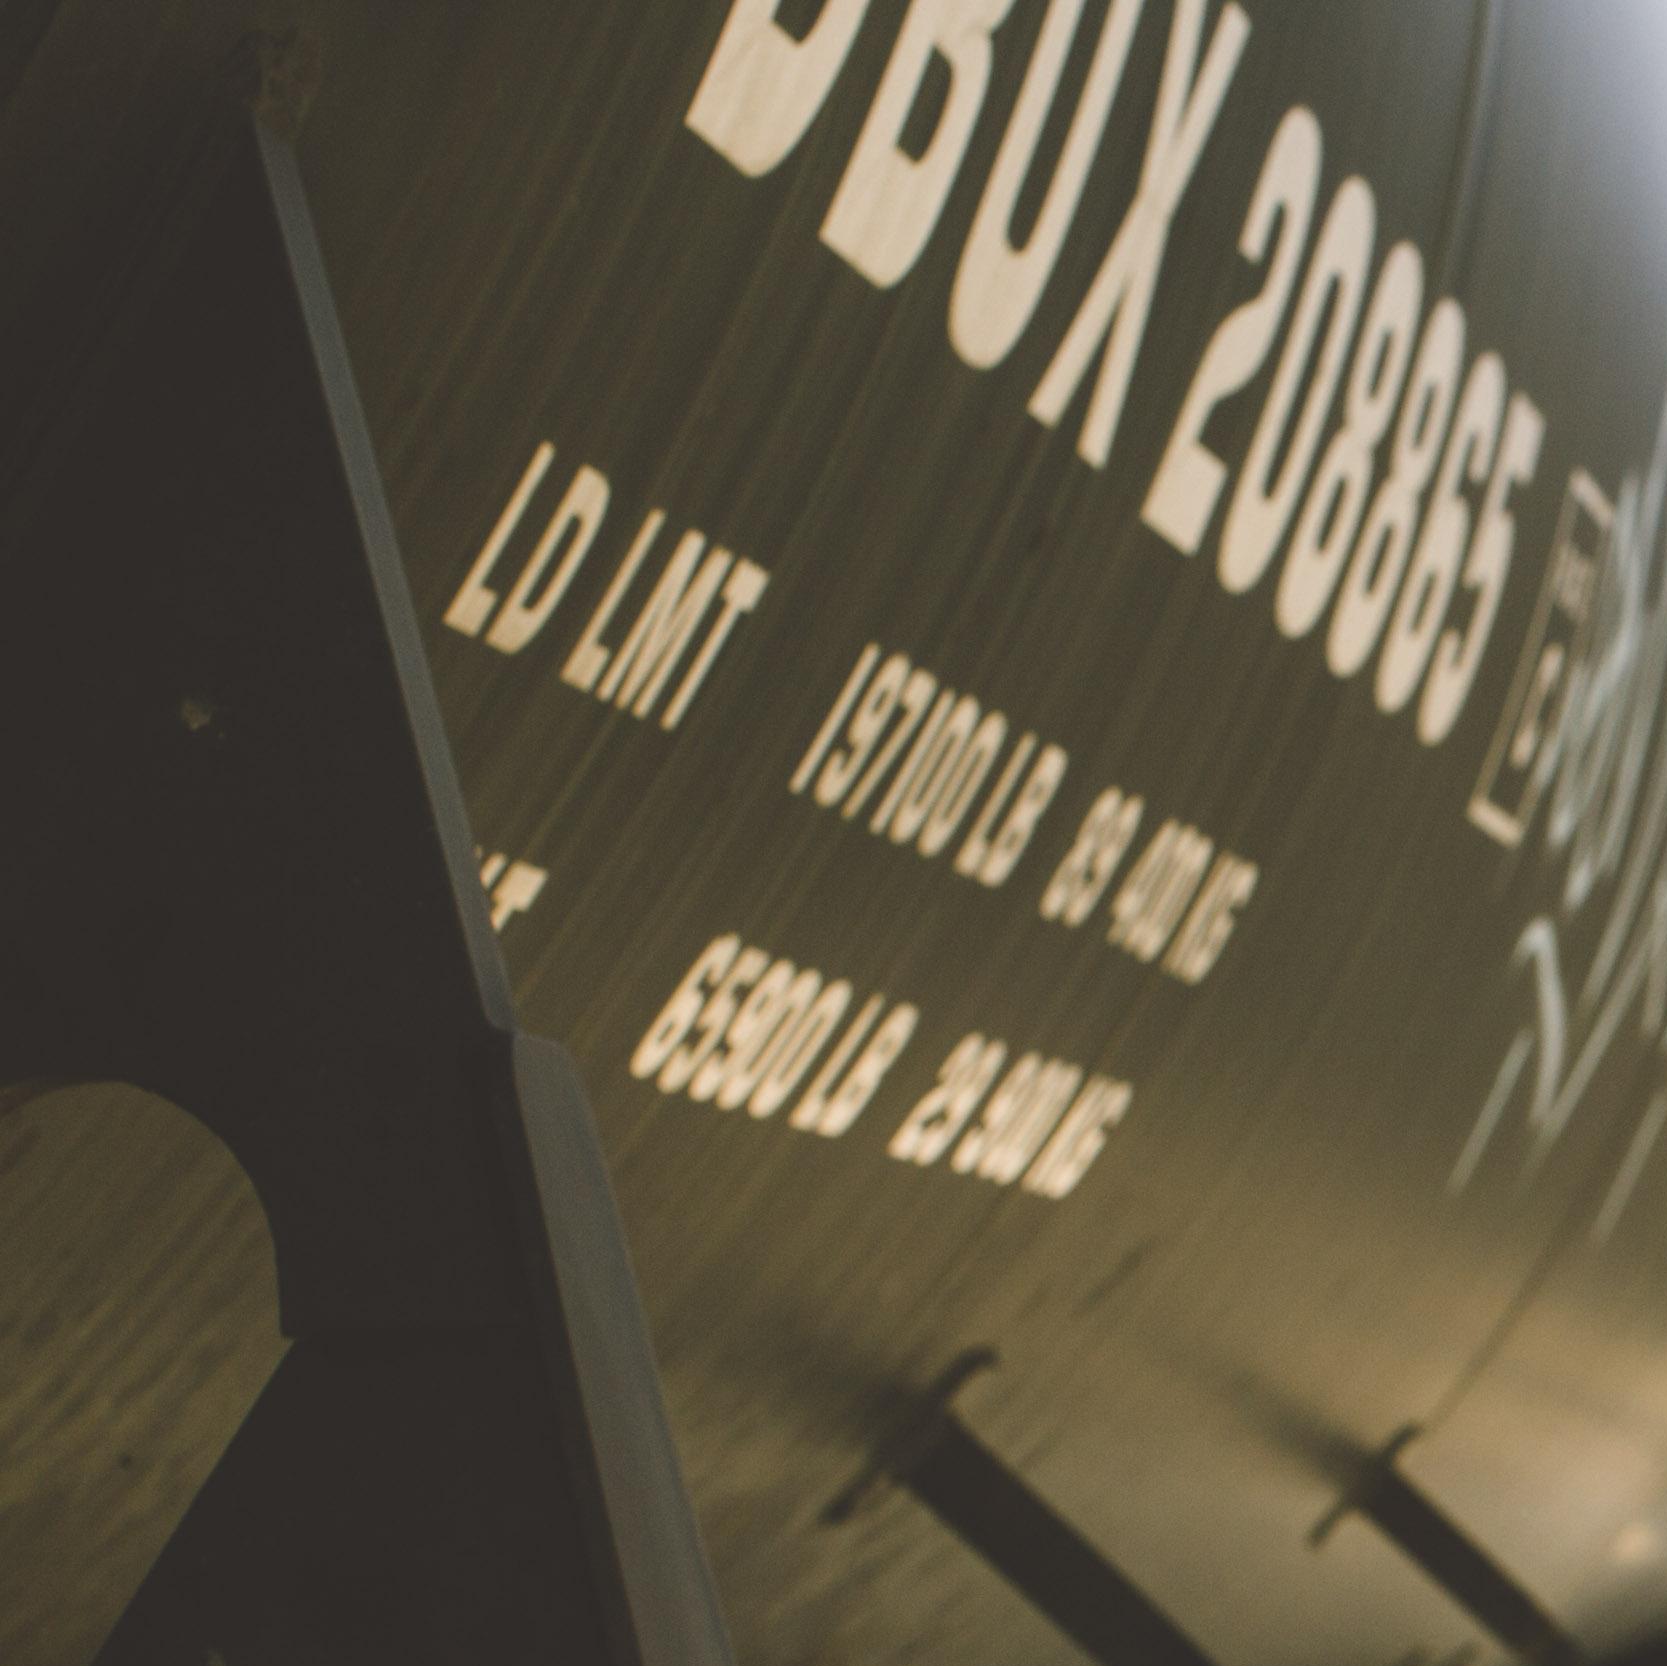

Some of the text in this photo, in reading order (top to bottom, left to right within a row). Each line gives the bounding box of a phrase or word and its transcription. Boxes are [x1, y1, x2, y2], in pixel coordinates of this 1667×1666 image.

[1141, 105, 1546, 746] 208865
[444, 441, 769, 730] LD LMT
[790, 643, 1008, 857] 197100
[955, 733, 1068, 888] LB
[631, 934, 852, 1119] 65900
[790, 995, 918, 1138] LB
